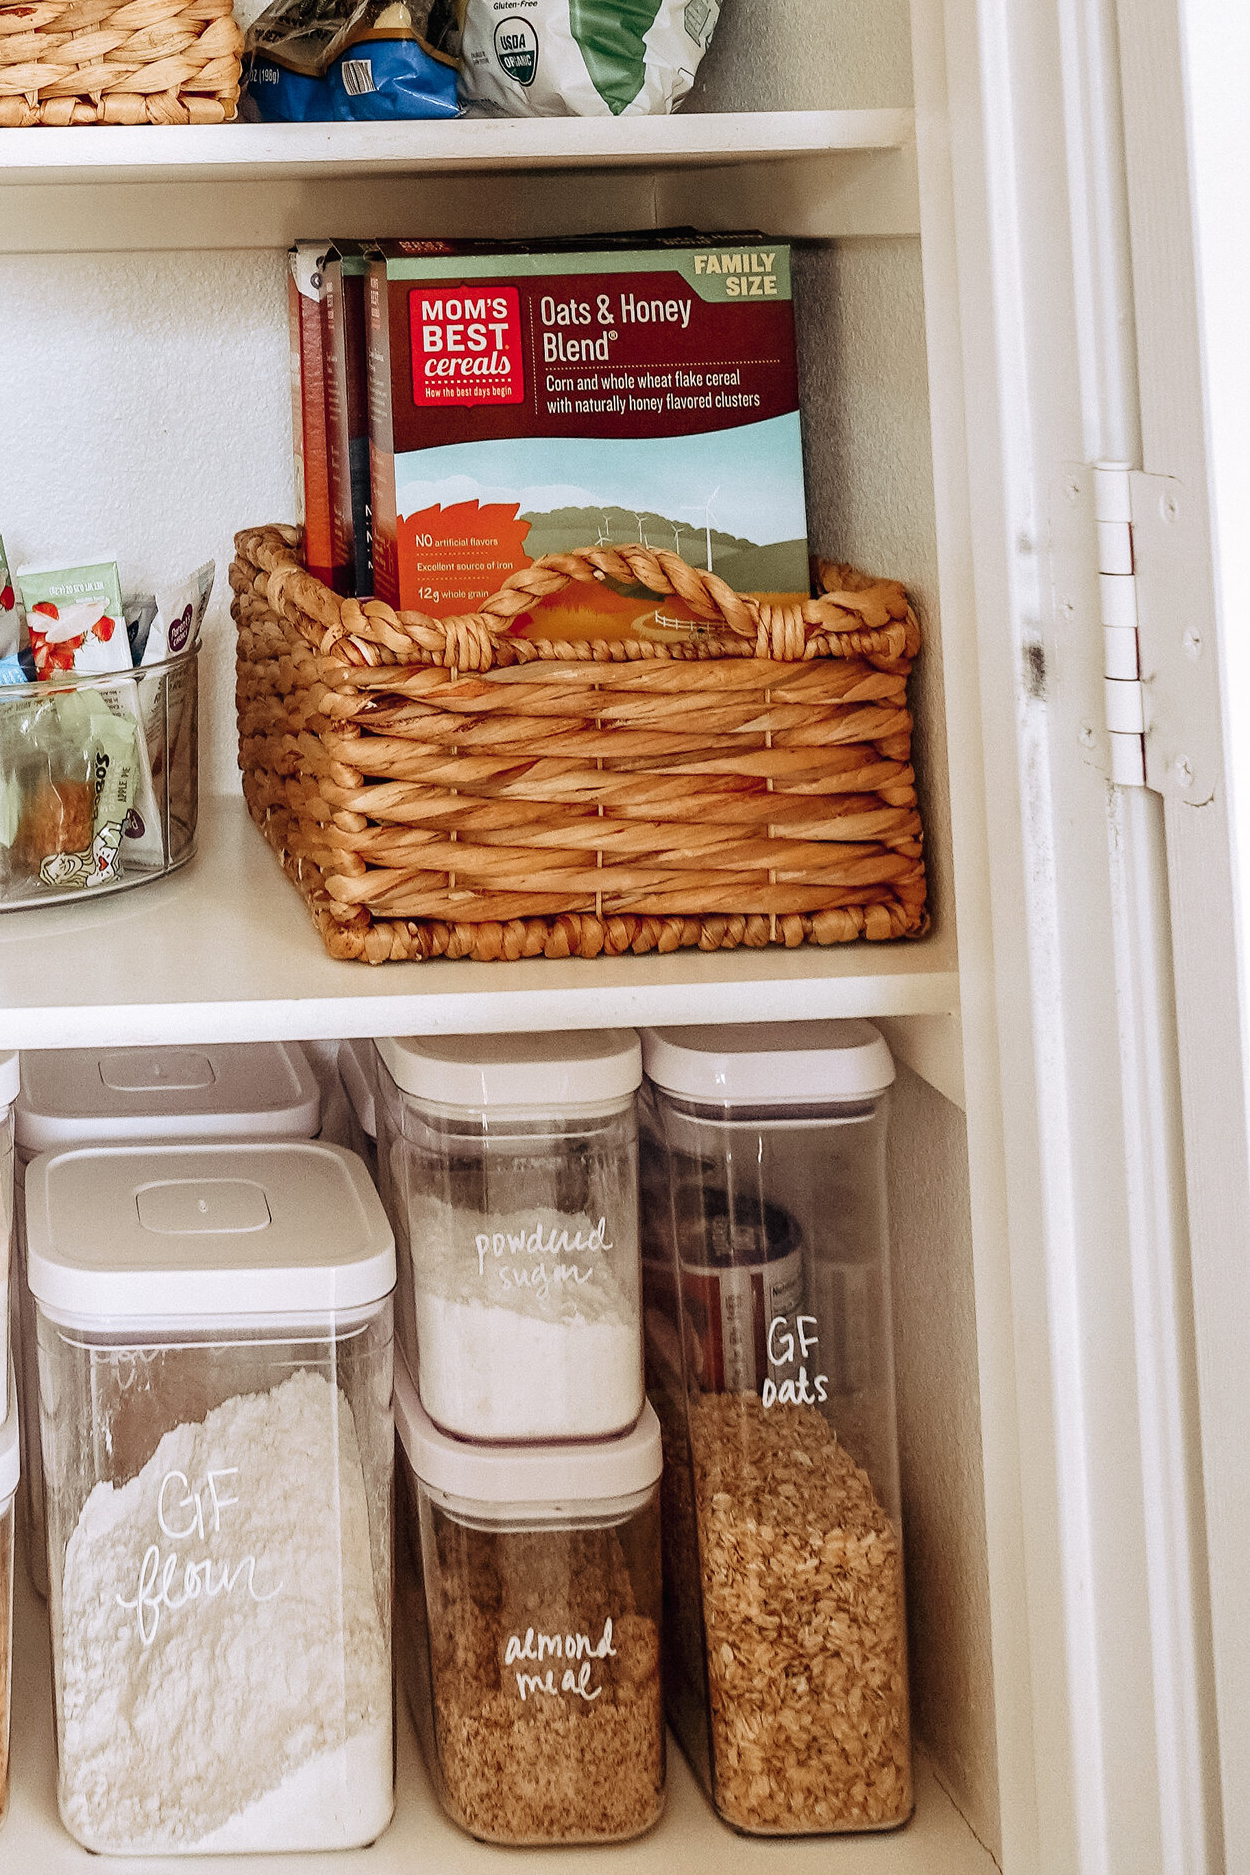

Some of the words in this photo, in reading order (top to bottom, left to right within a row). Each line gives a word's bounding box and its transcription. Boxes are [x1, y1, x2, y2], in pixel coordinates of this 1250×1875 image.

[500, 33, 526, 51] USDA
[693, 252, 776, 276] FAMILY
[725, 275, 778, 297] SIZE
[421, 297, 508, 321] MOM'S
[540, 295, 592, 326] Oats
[596, 293, 615, 325] &
[620, 292, 692, 329] Honey
[422, 322, 510, 353] BEST
[424, 350, 512, 377] cereals
[425, 387, 441, 398] How
[456, 386, 472, 397] best
[473, 385, 491, 399] days
[492, 385, 512, 398] begin
[546, 374, 574, 392] Corn
[577, 373, 599, 391] and
[601, 371, 636, 390] whole
[638, 371, 673, 390] wheat
[674, 369, 704, 389] flake
[705, 368, 741, 387] cereal
[546, 396, 573, 414] with
[575, 394, 626, 415] naturally
[628, 393, 664, 415] honey
[665, 392, 713, 411] flavored
[715, 390, 761, 408] clusters
[415, 532, 433, 548] NO
[434, 537, 469, 548] artificial
[470, 536, 499, 547] flavors
[486, 561, 496, 570] of
[496, 561, 514, 570] iron
[418, 586, 440, 604] 12g
[475, 1216, 614, 1275] powdered
[500, 1262, 594, 1300] sugar
[767, 1315, 820, 1367] GF
[762, 1366, 830, 1408] oats
[158, 1467, 240, 1539] GF
[115, 1544, 284, 1646] flour
[504, 1619, 617, 1670] almond
[515, 1651, 603, 1702] meal
